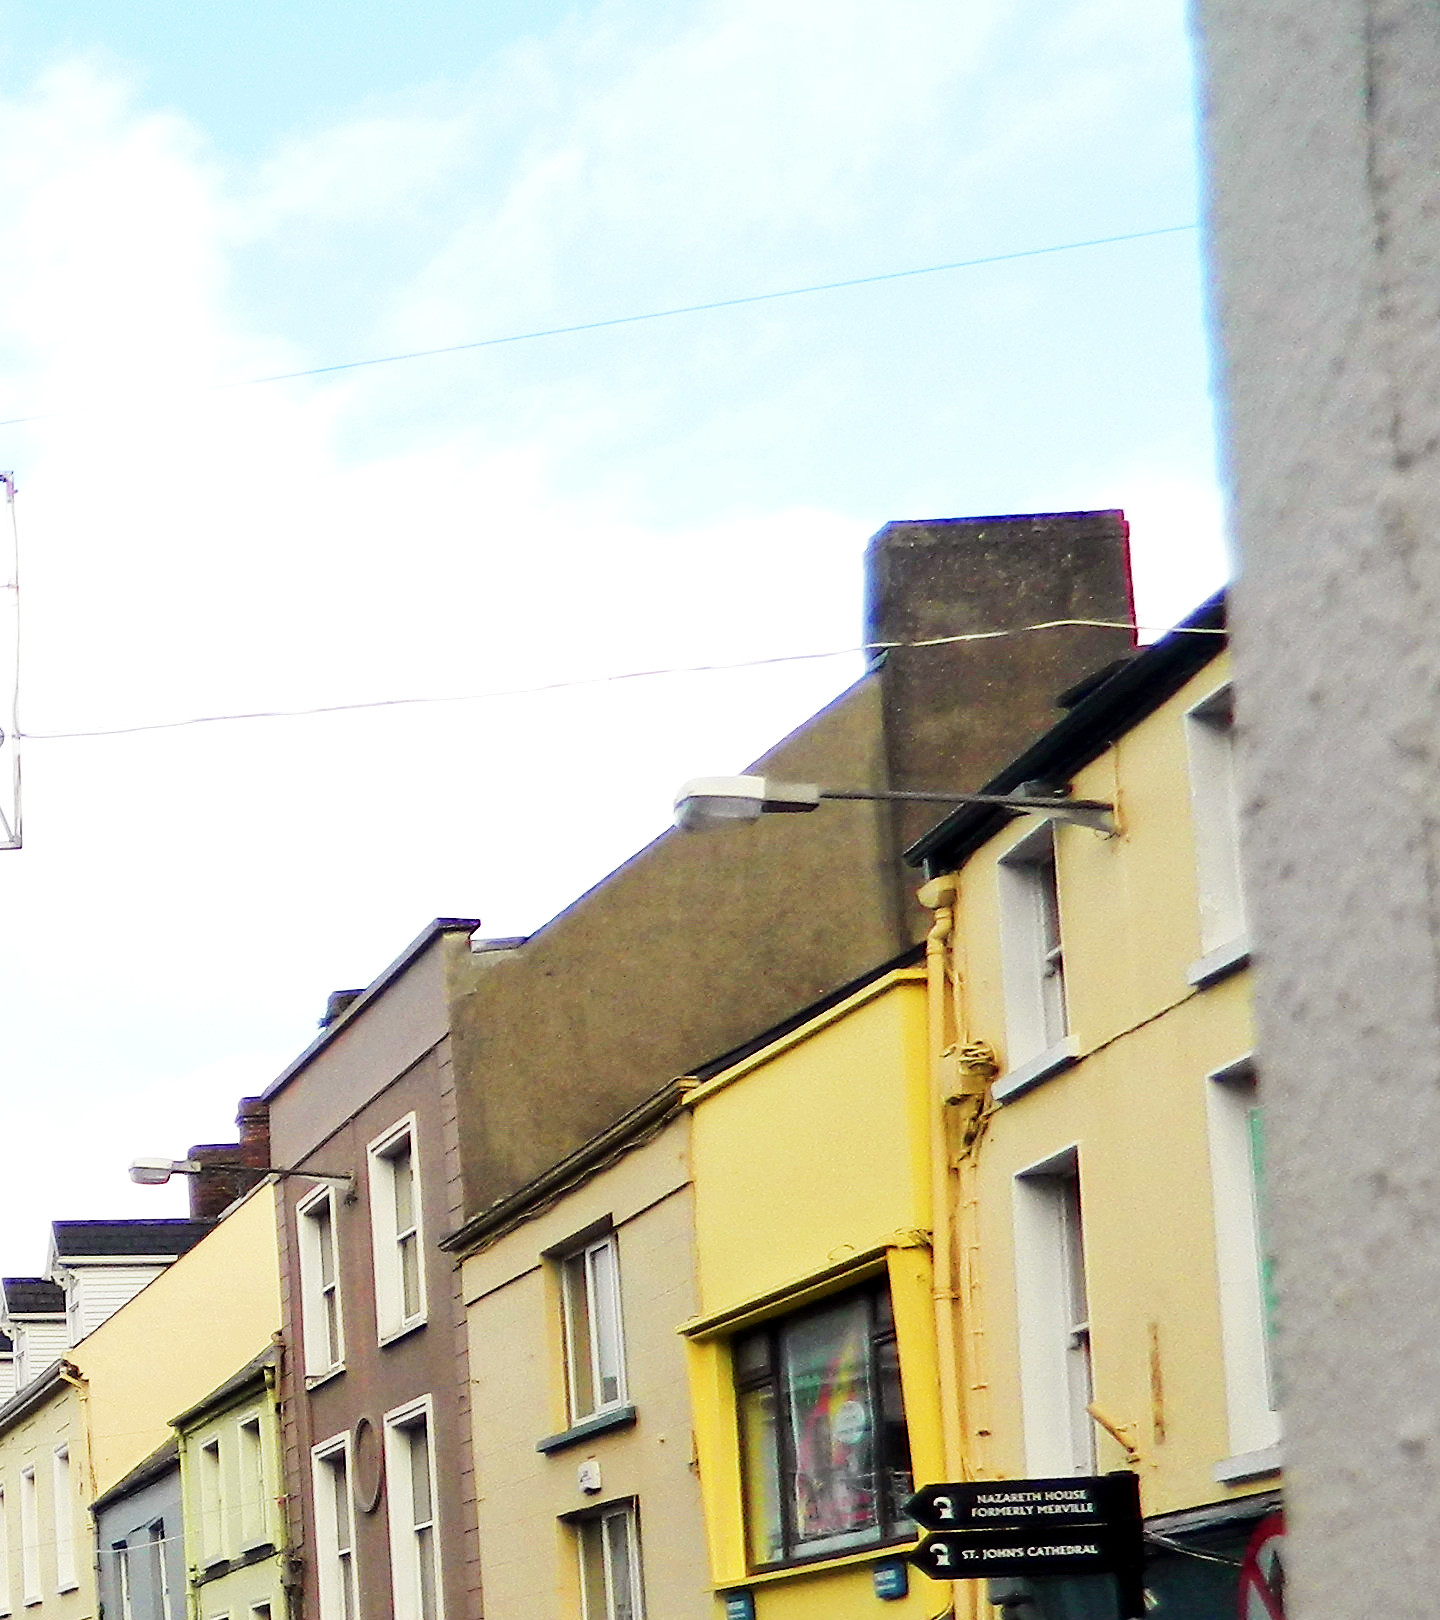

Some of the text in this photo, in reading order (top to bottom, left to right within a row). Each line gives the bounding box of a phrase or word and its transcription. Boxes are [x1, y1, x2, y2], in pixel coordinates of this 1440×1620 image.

[976, 1489, 1087, 1505] NAZARETH HOUSE
[971, 1502, 1094, 1518] FORMERLY MERVILLE
[961, 1544, 1098, 1560] ST. JOHN'S CATHEDRAL
